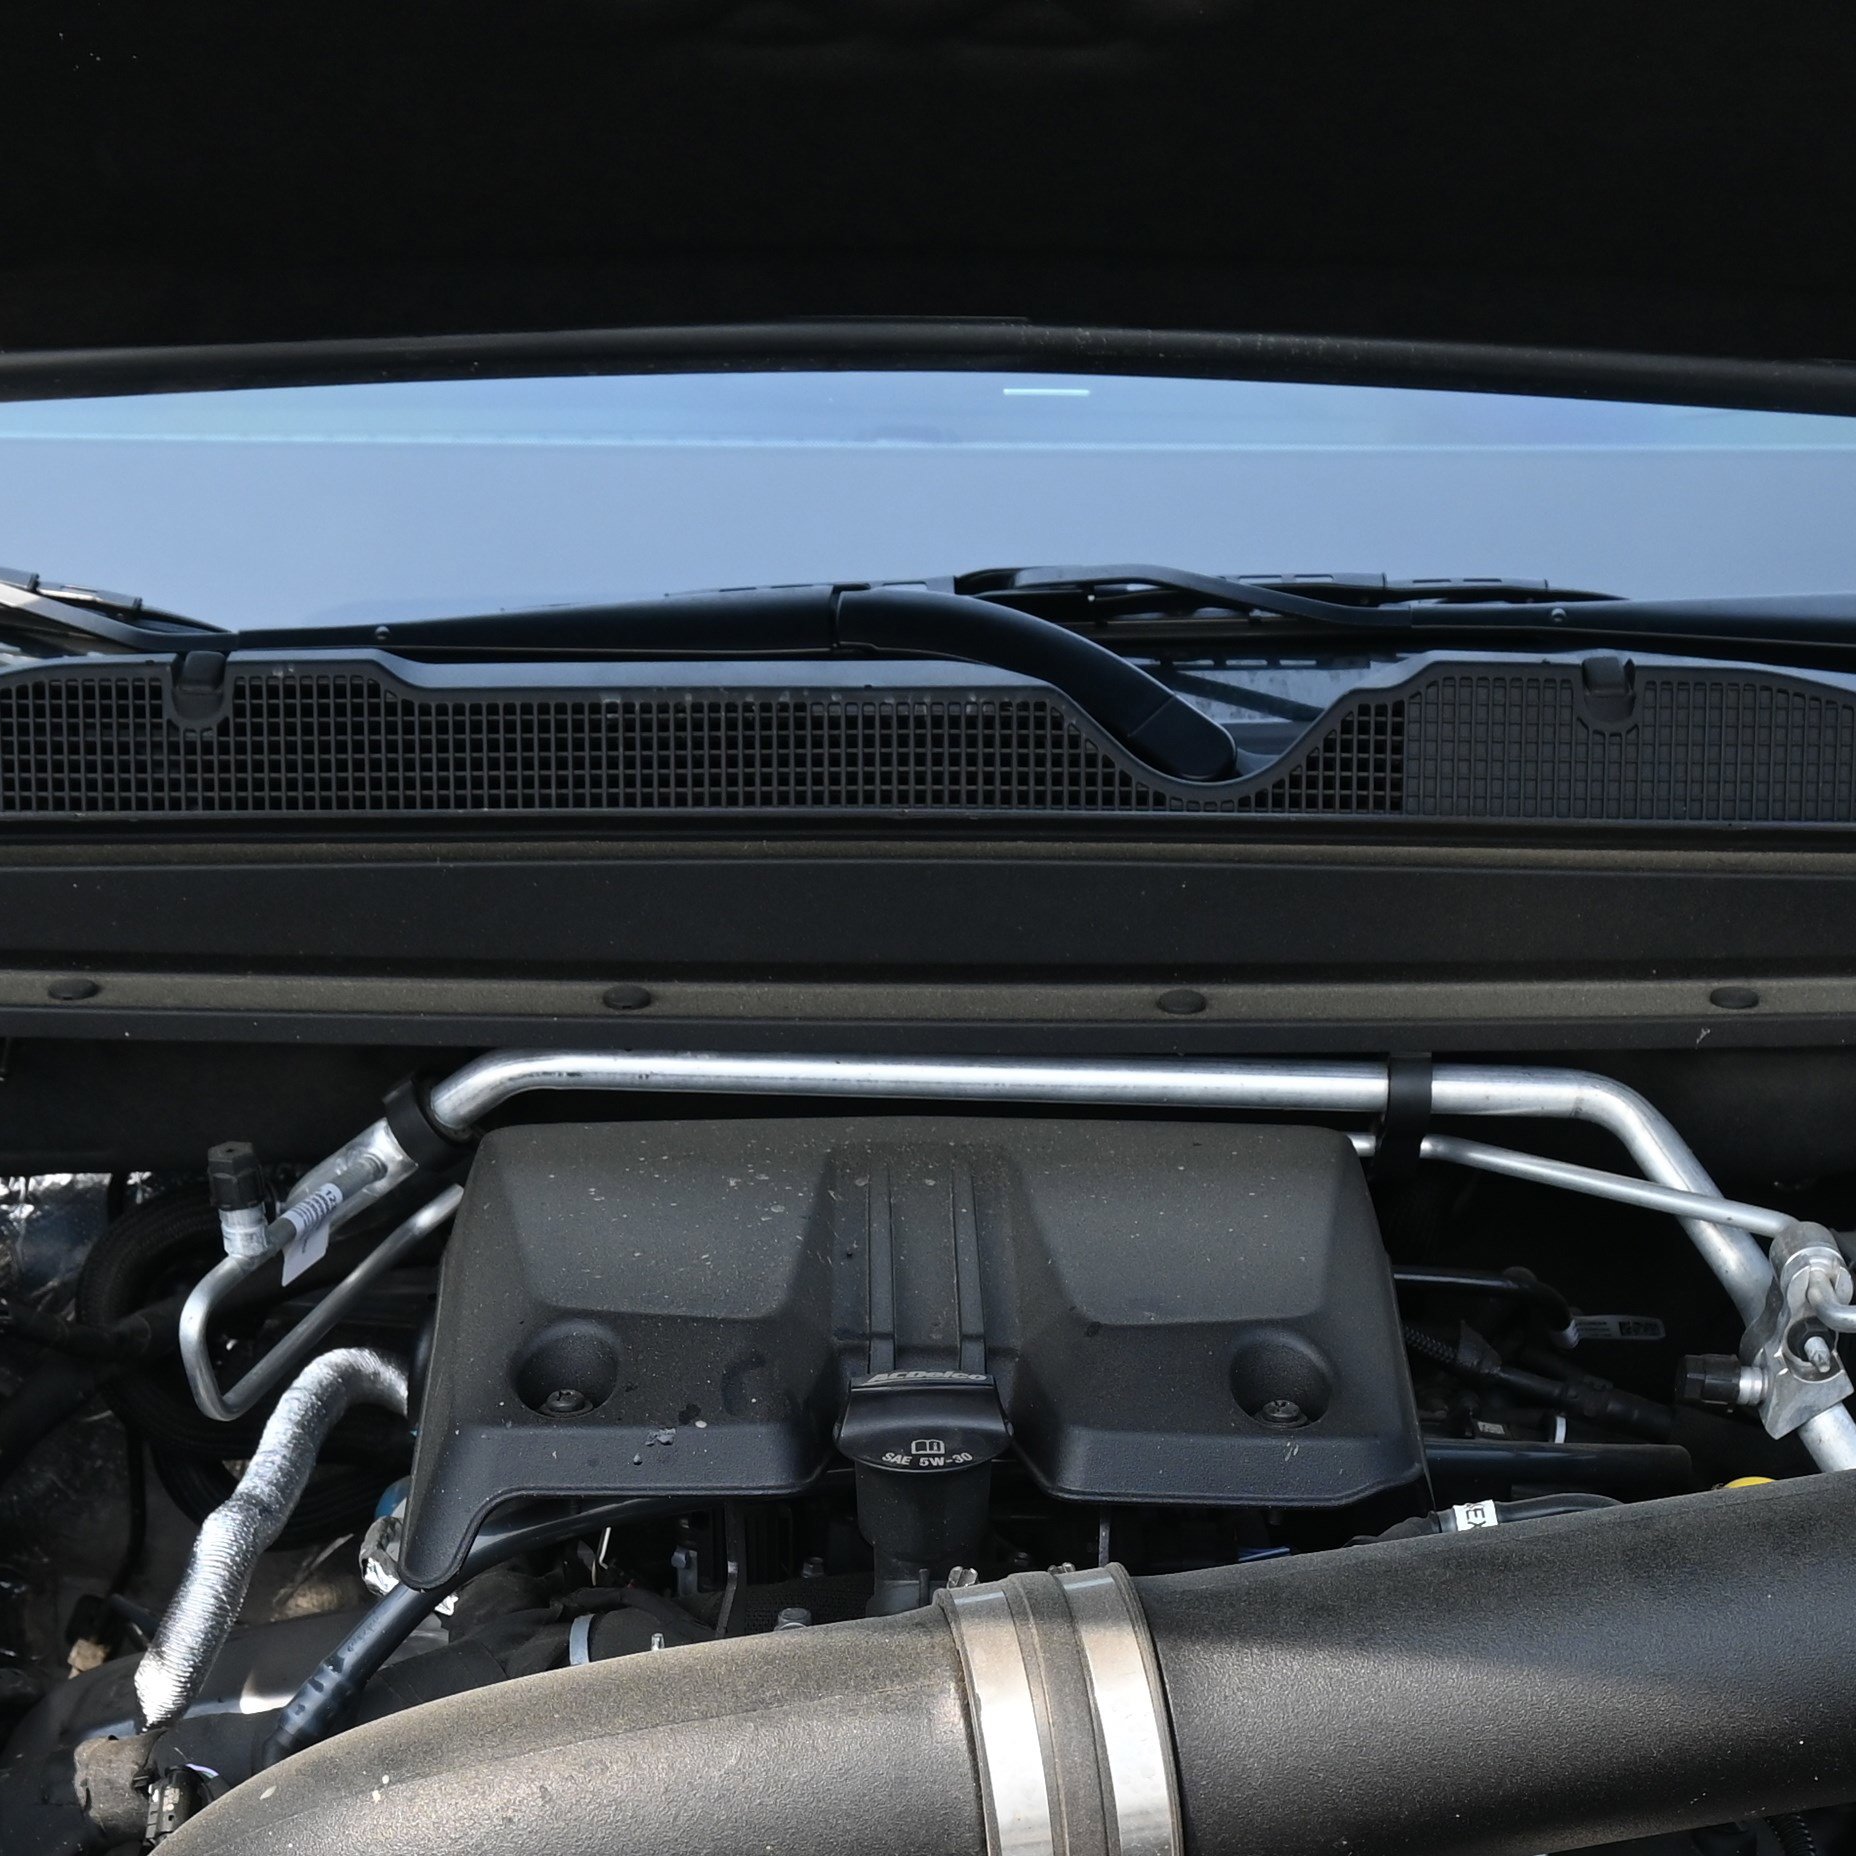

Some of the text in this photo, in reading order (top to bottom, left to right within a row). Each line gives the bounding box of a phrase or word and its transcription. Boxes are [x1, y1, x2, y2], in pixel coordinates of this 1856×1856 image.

[866, 1371, 988, 1384] ACDelco
[882, 1452, 973, 1466] SAE 5W-30
